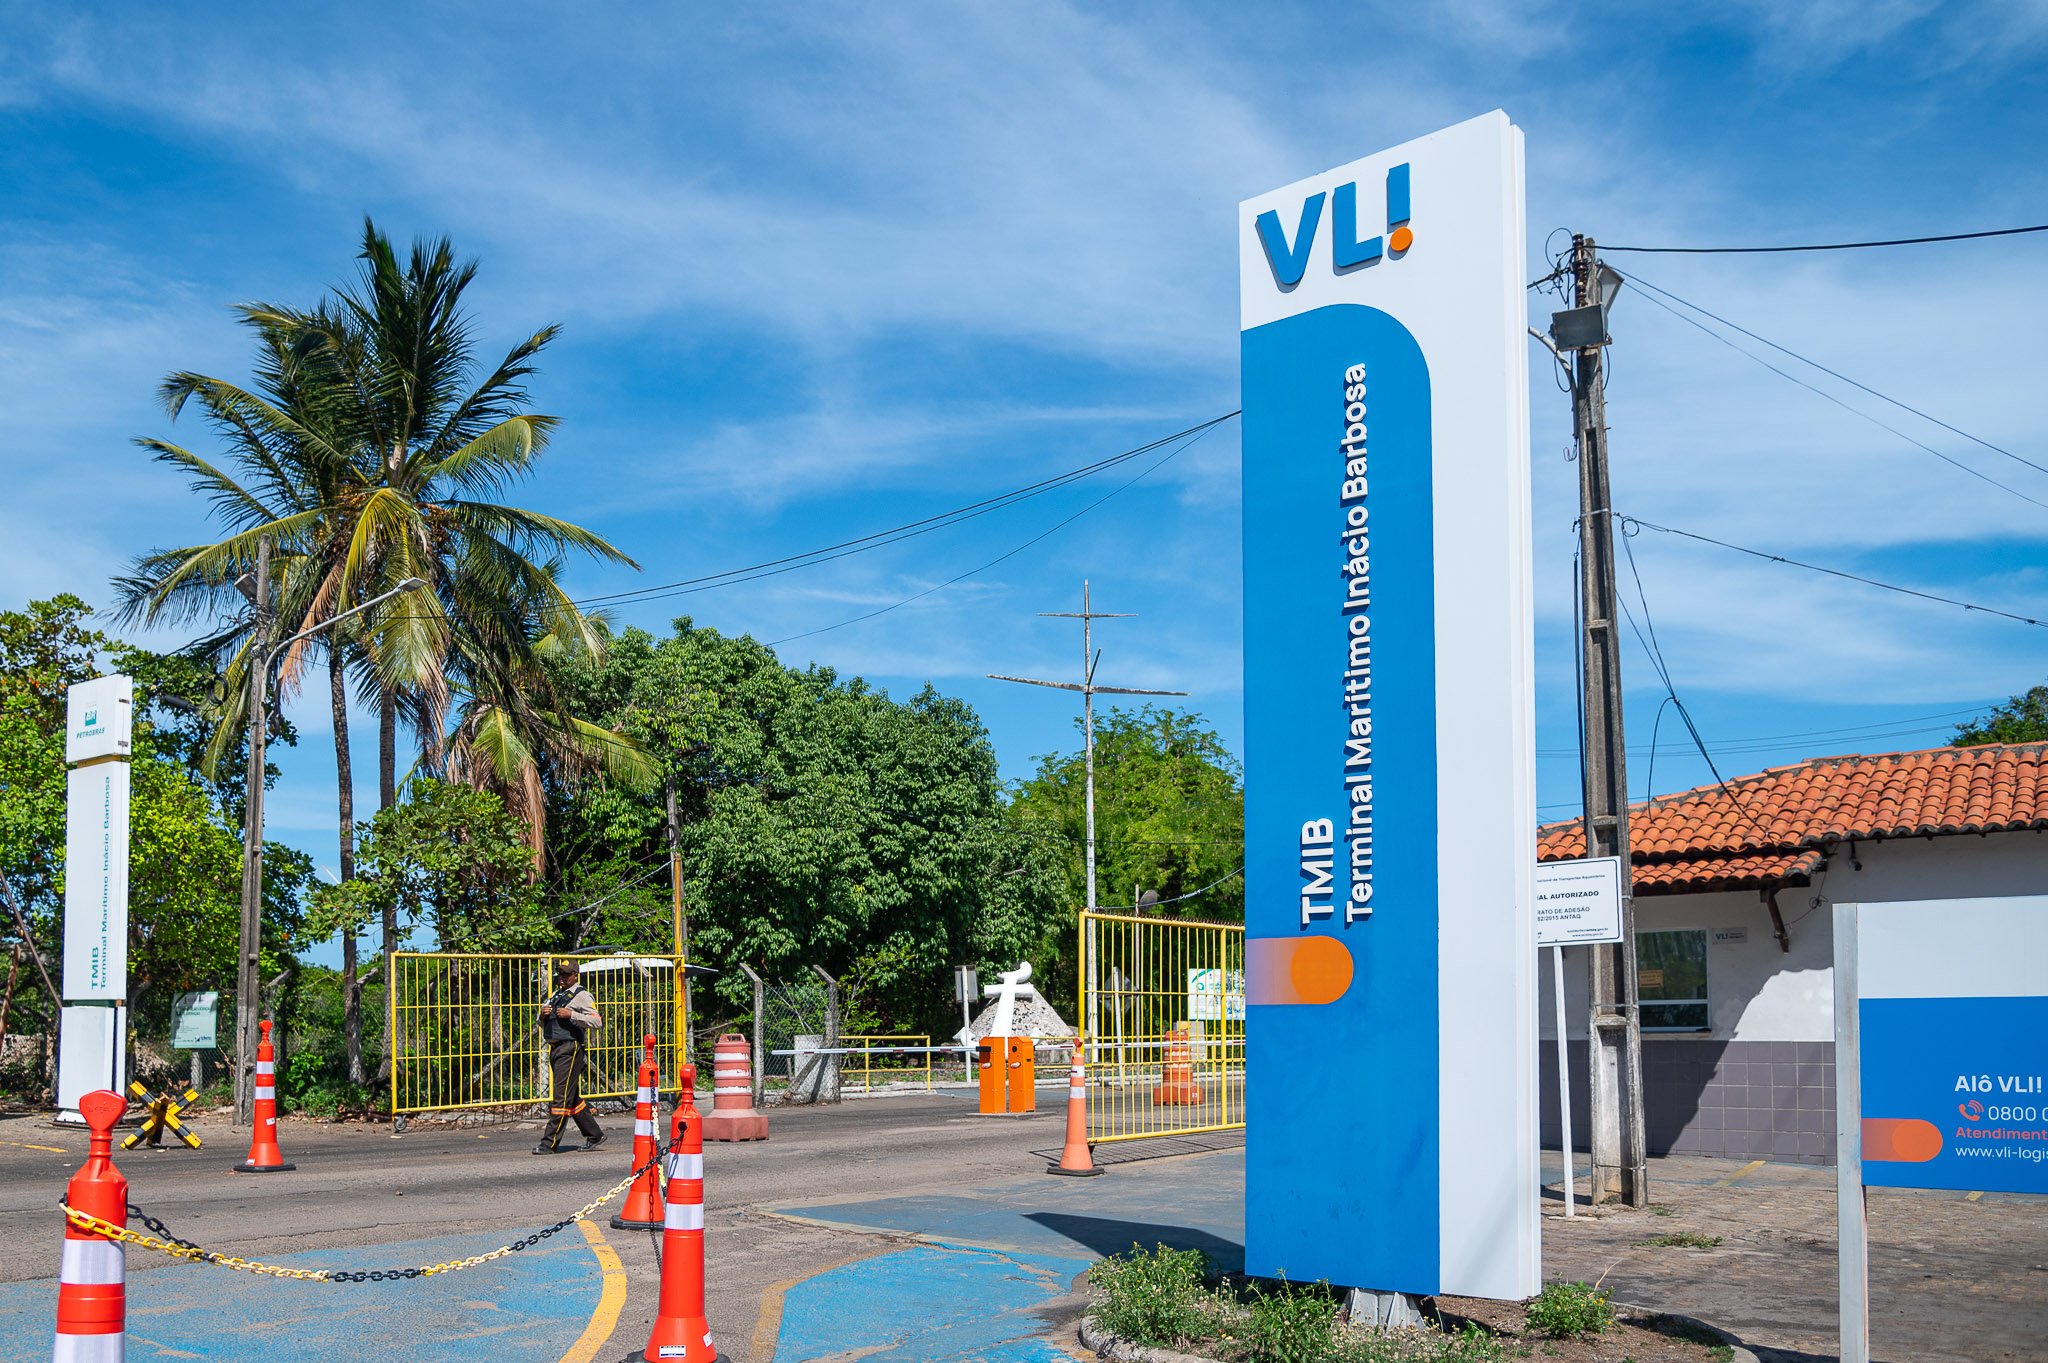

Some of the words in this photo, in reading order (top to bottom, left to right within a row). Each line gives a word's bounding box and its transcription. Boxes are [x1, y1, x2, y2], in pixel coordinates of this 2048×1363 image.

[1340, 362, 1369, 500] Barbosa
[1342, 505, 1371, 608] Inácio
[1344, 614, 1372, 767] Marítimo
[76, 727, 105, 739] PETROBRAS
[1346, 774, 1373, 923] Terminal
[1301, 817, 1334, 924] TMIB
[1550, 890, 1599, 900] AUTORIZADO
[91, 946, 99, 990] TMIB
[1954, 1074, 1993, 1092] Alô
[1997, 1076, 2042, 1093] VLI!
[1988, 1106, 2036, 1121] 0800
[1955, 1126, 2048, 1140] Atendiment
[1955, 1146, 2048, 1162] www.vli-logi
